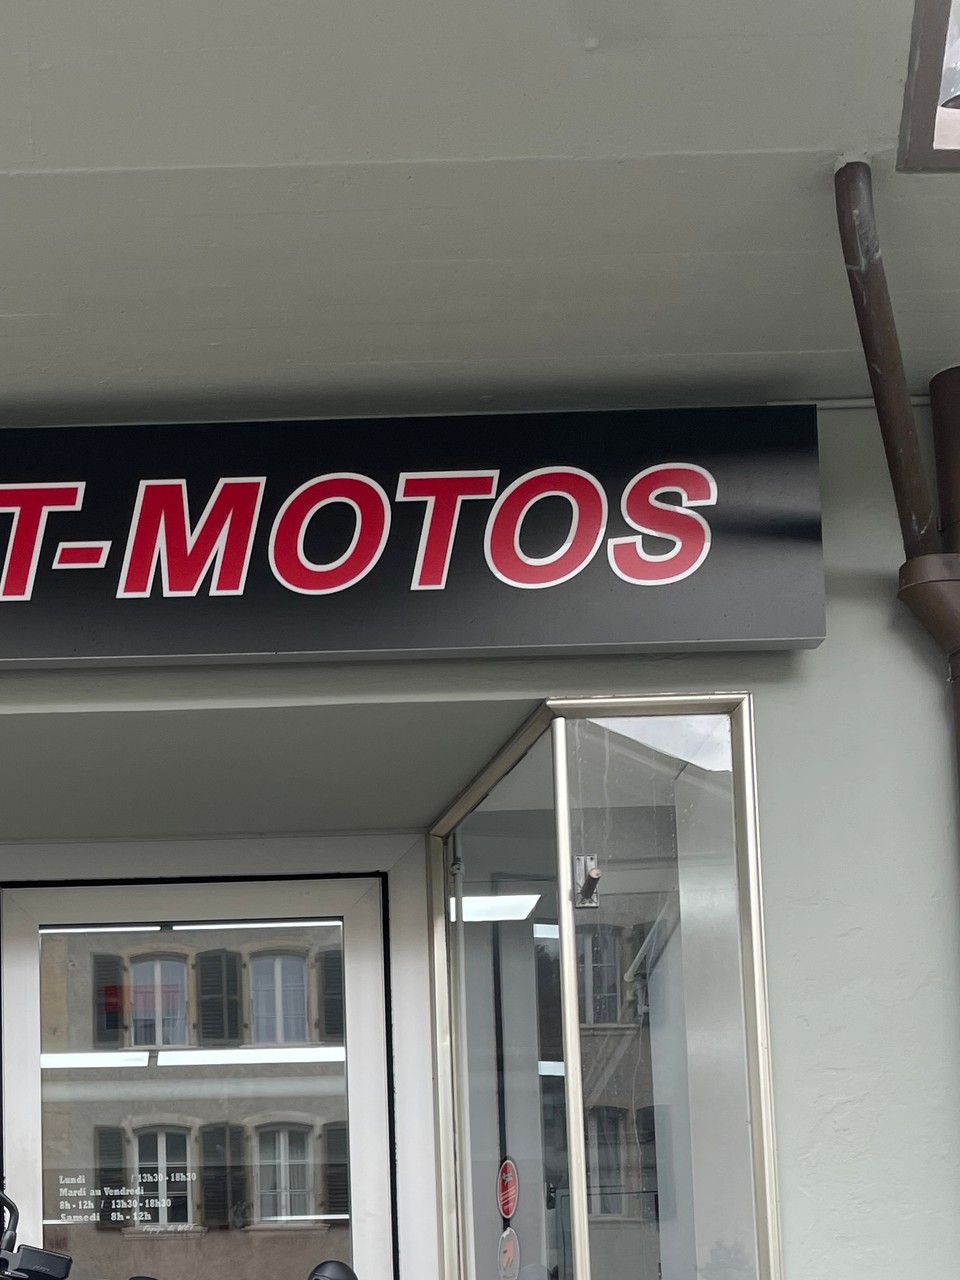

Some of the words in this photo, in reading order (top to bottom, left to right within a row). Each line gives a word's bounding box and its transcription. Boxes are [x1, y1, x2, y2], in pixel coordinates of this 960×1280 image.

[59, 1175, 86, 1184] Lundi
[138, 1173, 163, 1183] 13h30
[171, 1172, 197, 1182] 18h30
[59, 1187, 86, 1197] Mardi
[104, 1186, 144, 1196] Vendredi
[59, 1201, 71, 1210] 8h
[78, 1200, 94, 1209] 12h
[111, 1199, 137, 1209] 13h30
[145, 1198, 172, 1208] 18h30
[60, 1213, 100, 1222] Samedi
[110, 1212, 124, 1221] 8h
[133, 1211, 151, 1220] 12h
